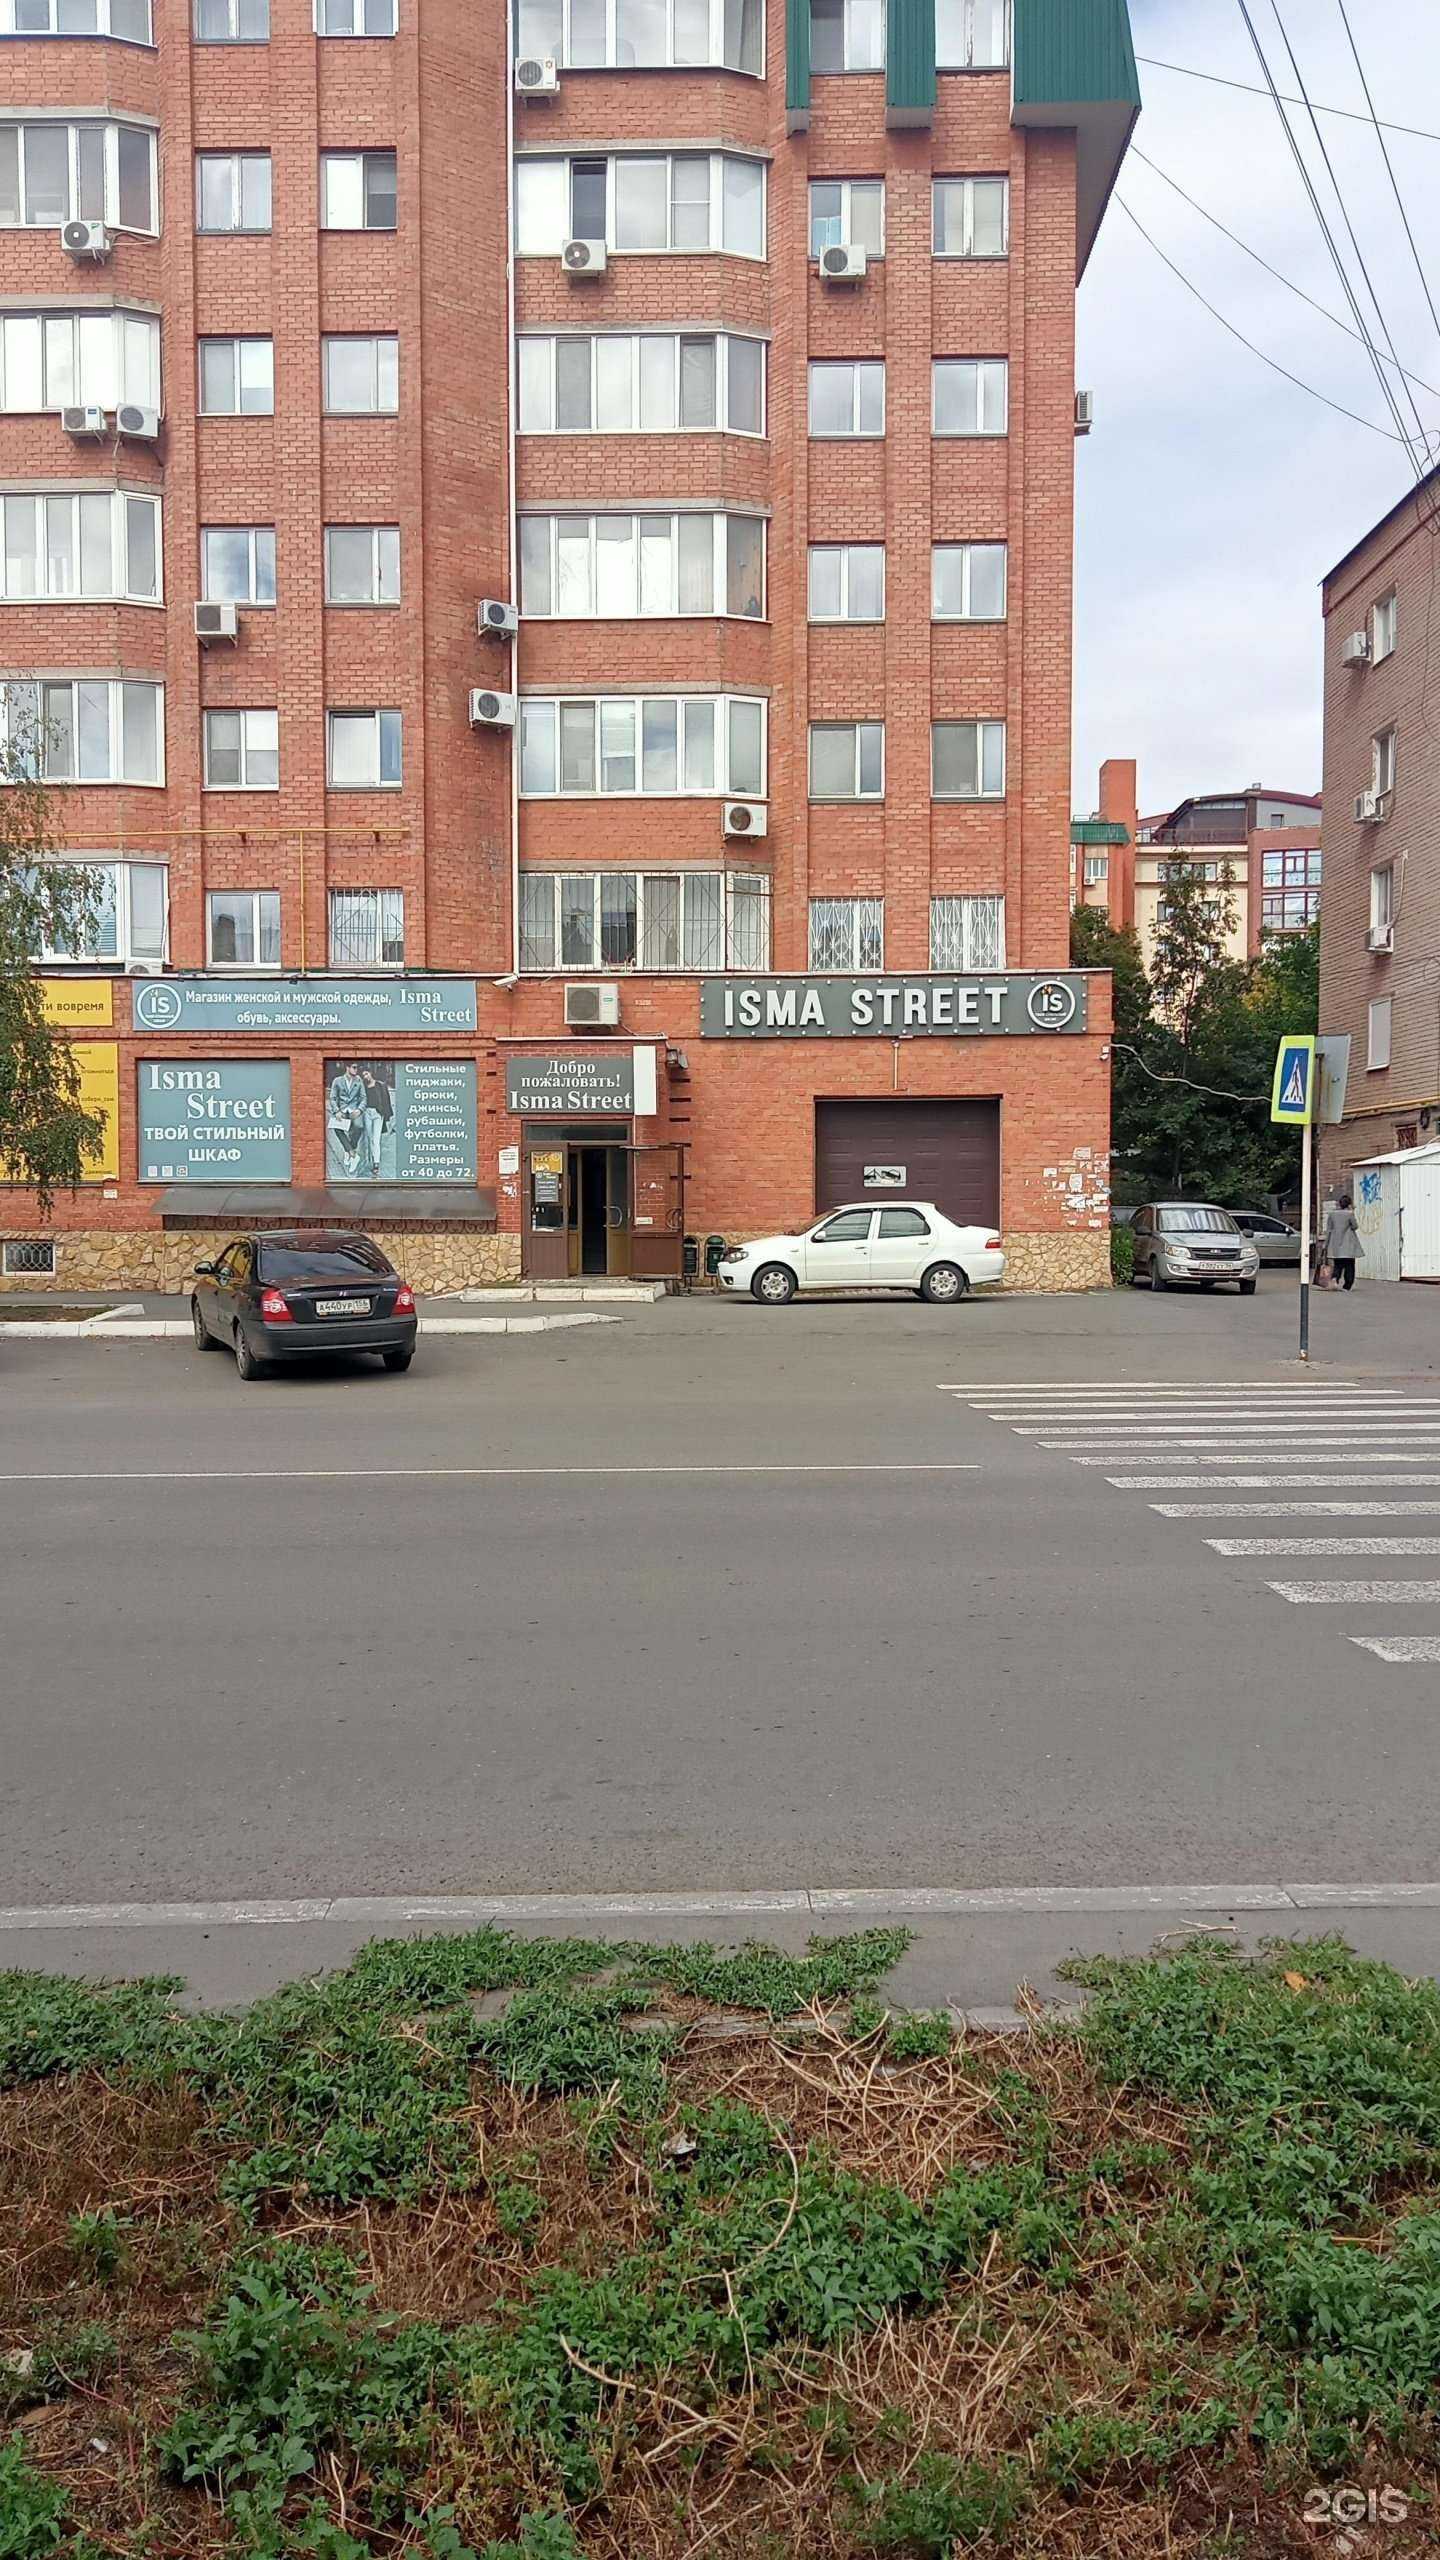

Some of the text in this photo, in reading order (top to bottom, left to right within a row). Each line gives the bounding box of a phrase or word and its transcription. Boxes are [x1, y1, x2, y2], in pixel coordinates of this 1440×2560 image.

[185, 990, 392, 1007] Магазин женской и мужской одежды,
[400, 988, 441, 1004] Isma
[57, 1002, 104, 1013] вовремя
[724, 986, 1008, 1027] ISMA STREET
[237, 1011, 342, 1026] обувь, аксессуары.
[421, 1007, 472, 1022] Street
[405, 1063, 467, 1074] Стильные
[546, 1060, 596, 1077] Добро
[148, 1064, 221, 1091] Isma
[405, 1076, 466, 1089] пиджаки,
[520, 1074, 621, 1088] пожаловать!
[414, 1089, 458, 1102] брюки,
[510, 1090, 632, 1109] Isma Street
[187, 1092, 276, 1119] Street
[408, 1103, 463, 1115] джинсы,
[406, 1115, 466, 1128] рубашки,
[144, 1124, 285, 1140] ТВОЙ СТИЛЬНЫЙ
[404, 1128, 468, 1141] футболки,
[413, 1142, 460, 1152] платья.
[188, 1148, 242, 1162] ШКАФ
[409, 1154, 464, 1166] Размеры
[401, 1169, 416, 1178] от
[418, 1167, 434, 1178] 40
[436, 1168, 453, 1179] до
